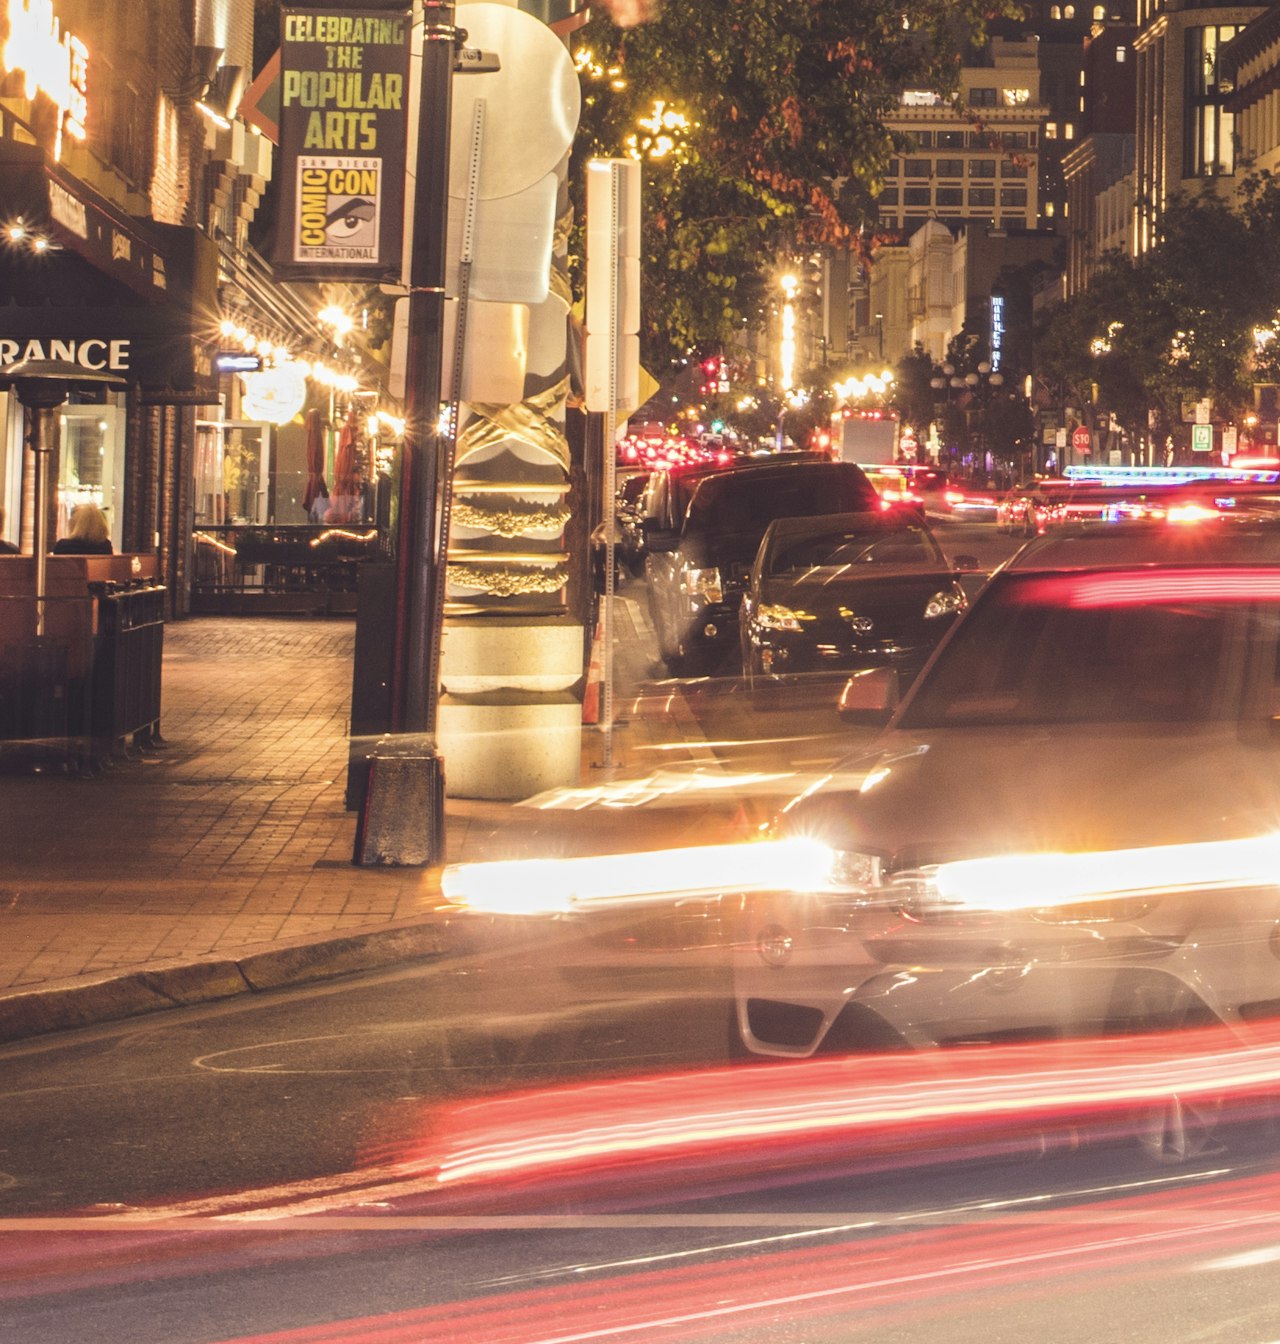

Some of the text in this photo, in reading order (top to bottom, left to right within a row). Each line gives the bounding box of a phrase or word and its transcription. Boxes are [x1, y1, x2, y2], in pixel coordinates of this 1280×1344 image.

[285, 14, 405, 46] CELEBRATING
[325, 45, 364, 69] THE
[283, 70, 403, 110] POPULAR
[304, 110, 377, 151] ARTS
[301, 159, 379, 168] SAN DIEGO
[328, 169, 376, 196] CON
[301, 169, 328, 246] COMIC
[301, 246, 375, 260] INTERNATIONAL
[1074, 433, 1089, 445] STO
